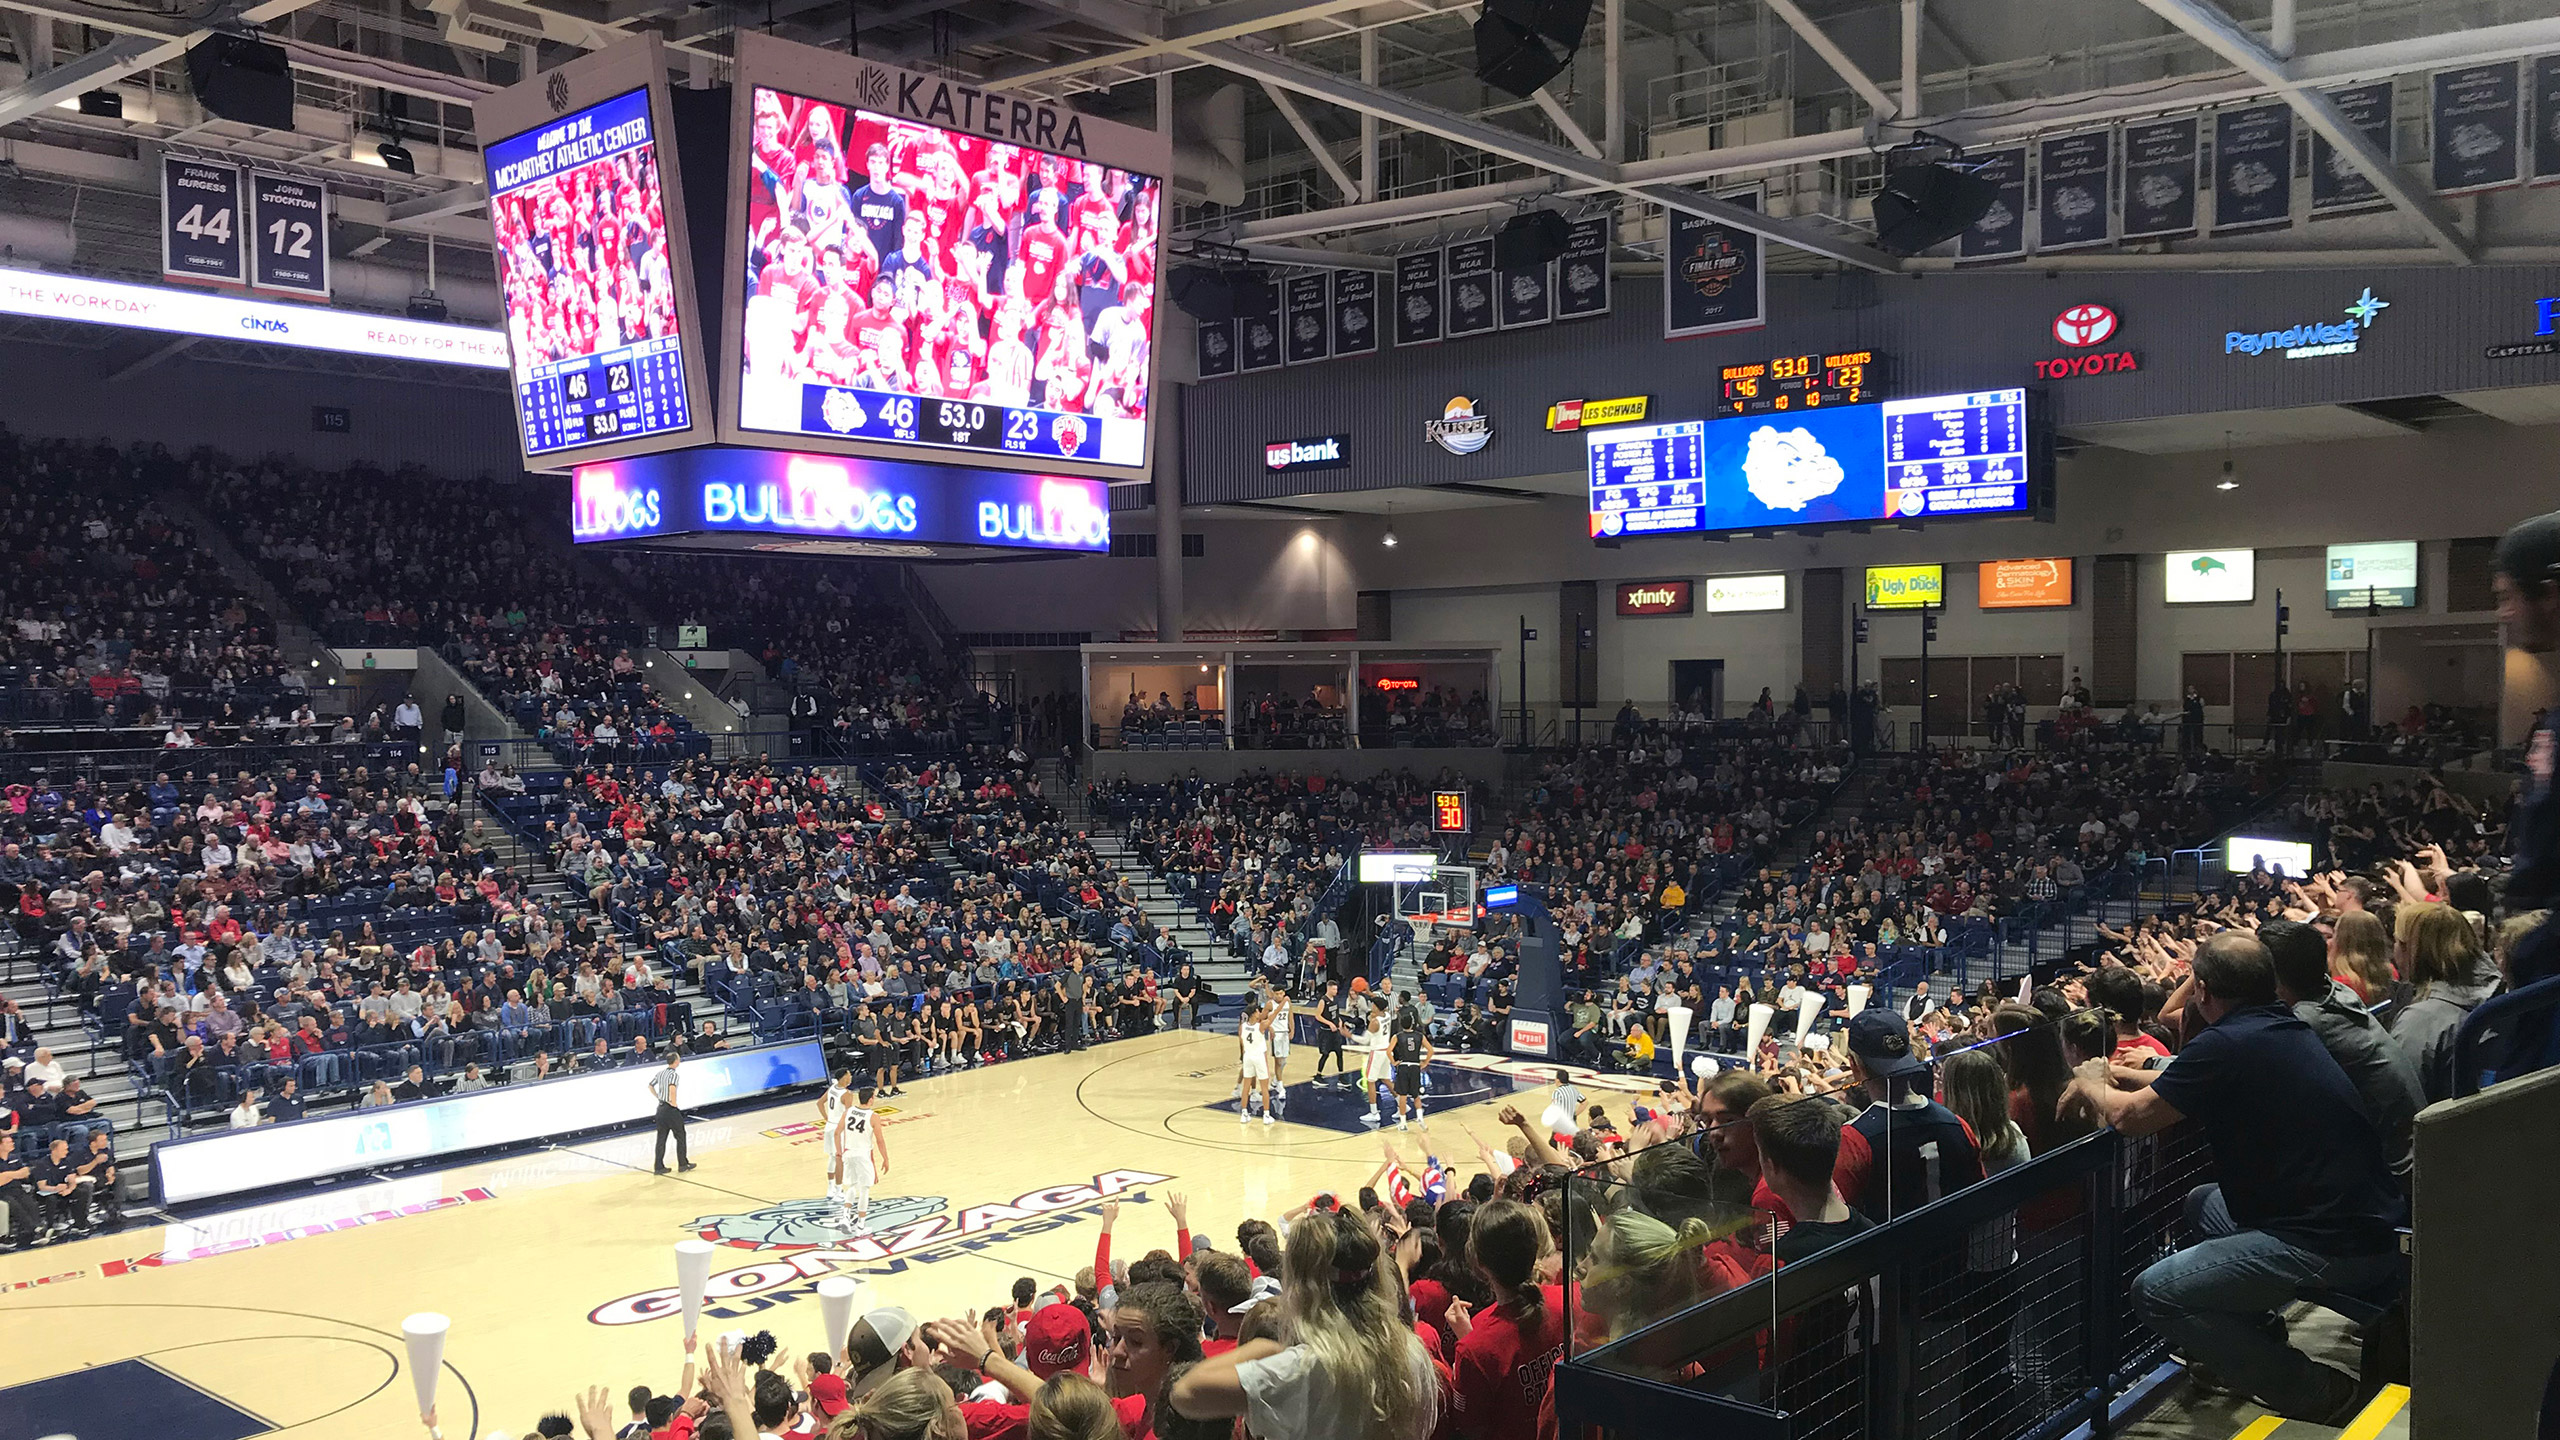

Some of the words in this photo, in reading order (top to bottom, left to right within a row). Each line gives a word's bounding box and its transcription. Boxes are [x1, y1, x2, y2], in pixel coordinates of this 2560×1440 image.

[897, 72, 1087, 156] KATERRA
[495, 151, 554, 190] MCCARTHEY
[556, 132, 603, 169] ATHLETIC
[604, 117, 647, 152] CENTER
[184, 168, 219, 180] FRANK
[178, 178, 226, 193] BURGESS
[274, 184, 303, 196] JOHN
[262, 193, 316, 209] STOCKTON
[176, 204, 231, 244] 44
[269, 219, 313, 259] 12
[1570, 237, 1595, 249] NCAA
[1459, 259, 1482, 269] NCAA
[1689, 259, 1713, 273] FINAL
[1714, 256, 1737, 269] FOUR
[1406, 271, 1429, 281] NCAA
[9, 286, 44, 302] THE
[1705, 306, 1723, 315] 2017
[367, 330, 417, 346] READY
[425, 337, 453, 350] FOR
[461, 341, 486, 354] THE
[2225, 318, 2360, 356] PayneWest
[2286, 342, 2358, 359] INSURANCE
[1772, 356, 1809, 379] 53.0
[1825, 352, 1872, 368] WILDCATS
[2034, 352, 2137, 379] TOYOTA
[609, 365, 630, 391] 23
[1723, 364, 1765, 380] BULLDOGS
[1839, 366, 1863, 387] 23
[568, 373, 588, 398] 46
[1735, 378, 1757, 397] 46
[1775, 395, 1789, 410] 10
[1806, 391, 1820, 407] 10
[1849, 387, 1860, 403] 2
[879, 397, 914, 428] 46
[1556, 405, 1581, 424] Tires
[1583, 408, 1599, 420] LES
[1601, 403, 1643, 418] SCHWAB
[1733, 401, 1743, 413] 4
[324, 413, 344, 426] 115
[593, 413, 618, 435] 53.0
[939, 402, 985, 430] 53.0
[1008, 410, 1039, 440] 23
[1424, 419, 1489, 443] KALISPEL
[952, 431, 970, 443] 1ST
[1903, 465, 1923, 476] FG
[1942, 461, 1969, 473] 3FG
[1987, 458, 2006, 470] FT
[1674, 483, 1689, 495] FT
[704, 482, 917, 532] BULLDOGS
[1996, 570, 2052, 578] Dermatology
[1996, 578, 2006, 588] &
[2007, 577, 2034, 585] SKIN
[1883, 578, 1907, 595] Ugly
[1910, 577, 1939, 590] Duck
[1437, 795, 1459, 807] 53.0
[1441, 807, 1462, 828] 30
[1246, 1033, 1253, 1043] 4
[1407, 1037, 1415, 1051] 5
[1518, 1032, 1542, 1043] bryant
[829, 1097, 835, 1110] 0
[847, 1117, 866, 1133] 24
[1919, 1141, 1941, 1201] 1
[587, 1167, 1179, 1326] GONZAGA
